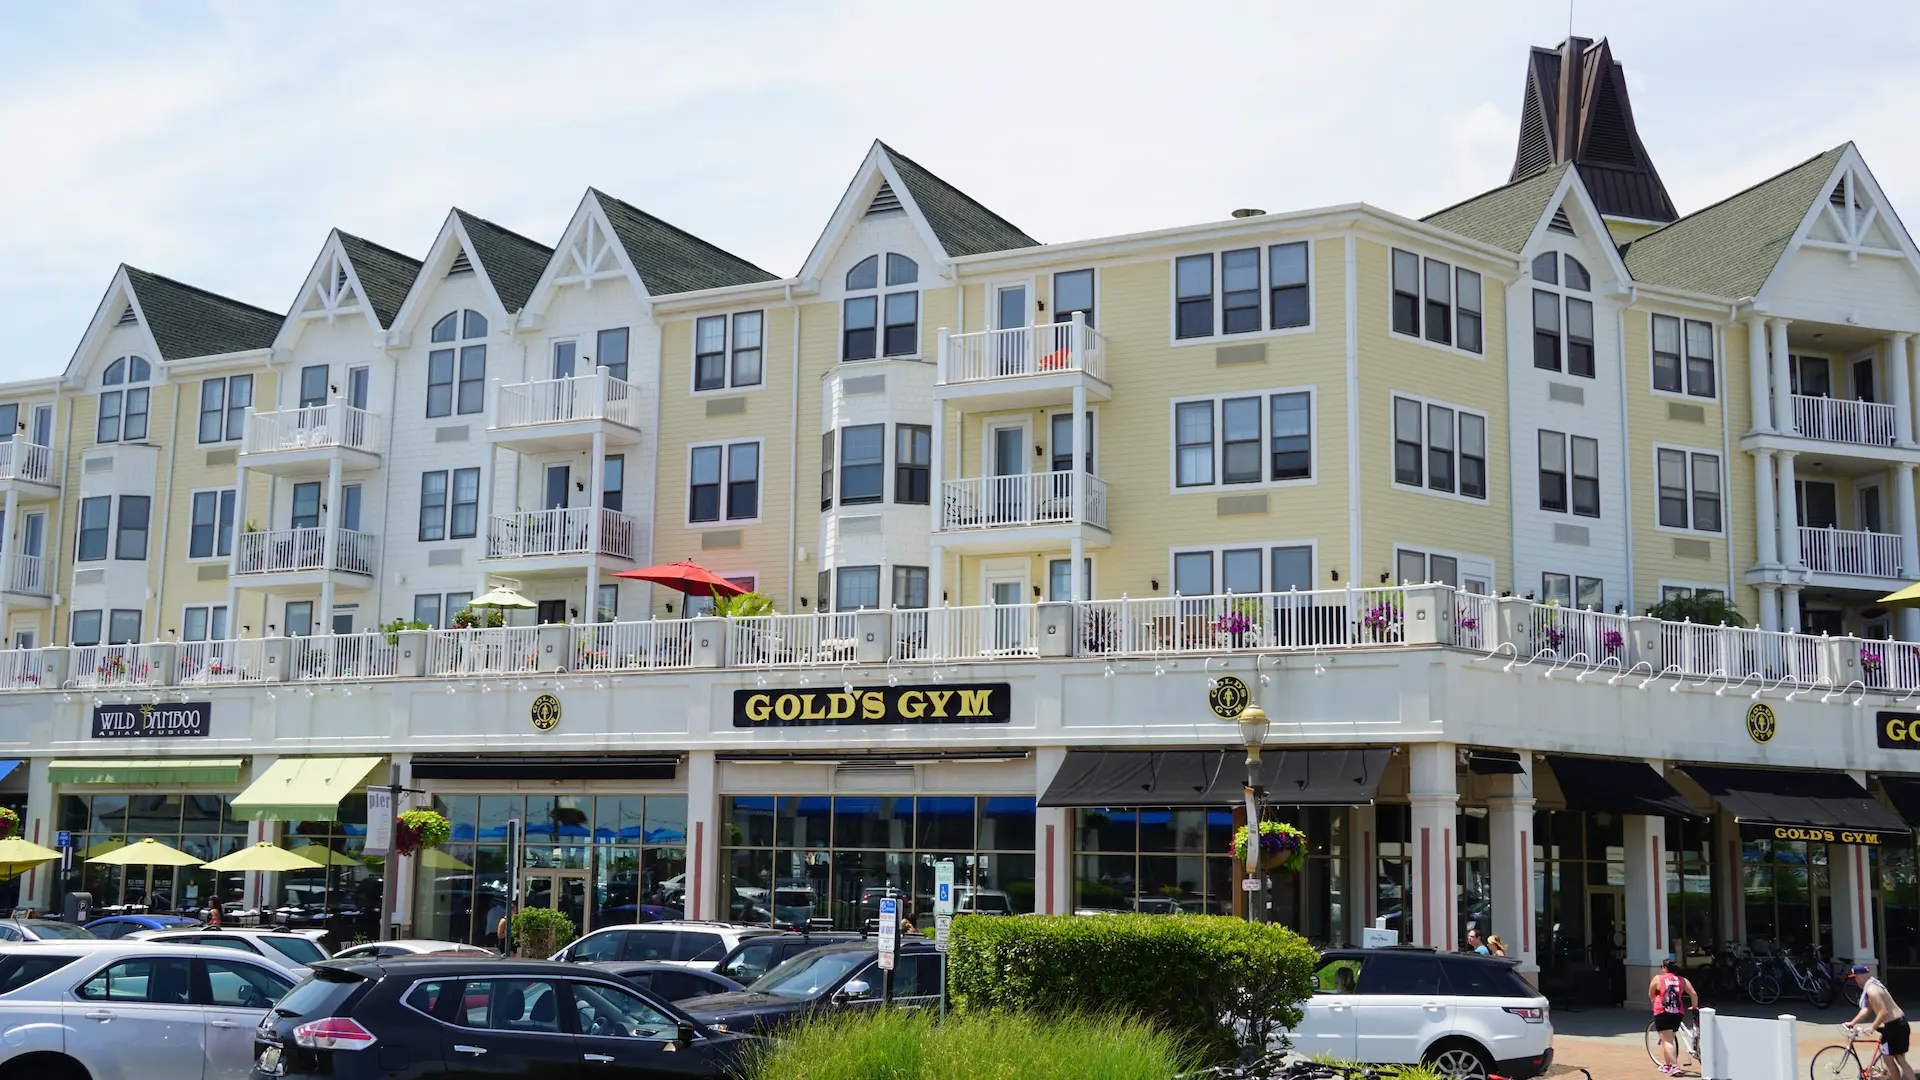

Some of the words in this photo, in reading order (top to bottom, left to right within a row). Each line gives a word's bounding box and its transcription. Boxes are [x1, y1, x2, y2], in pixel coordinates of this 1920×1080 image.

[745, 690, 886, 721] GOLD'S
[897, 689, 994, 720] GYM
[1214, 703, 1243, 716] GYM
[100, 712, 136, 730] WILD
[143, 710, 201, 730] BAMBOO
[534, 717, 556, 728] GYM
[369, 793, 390, 809] pier
[1774, 828, 1835, 842] GOLD'S
[1841, 832, 1880, 844] GYM
